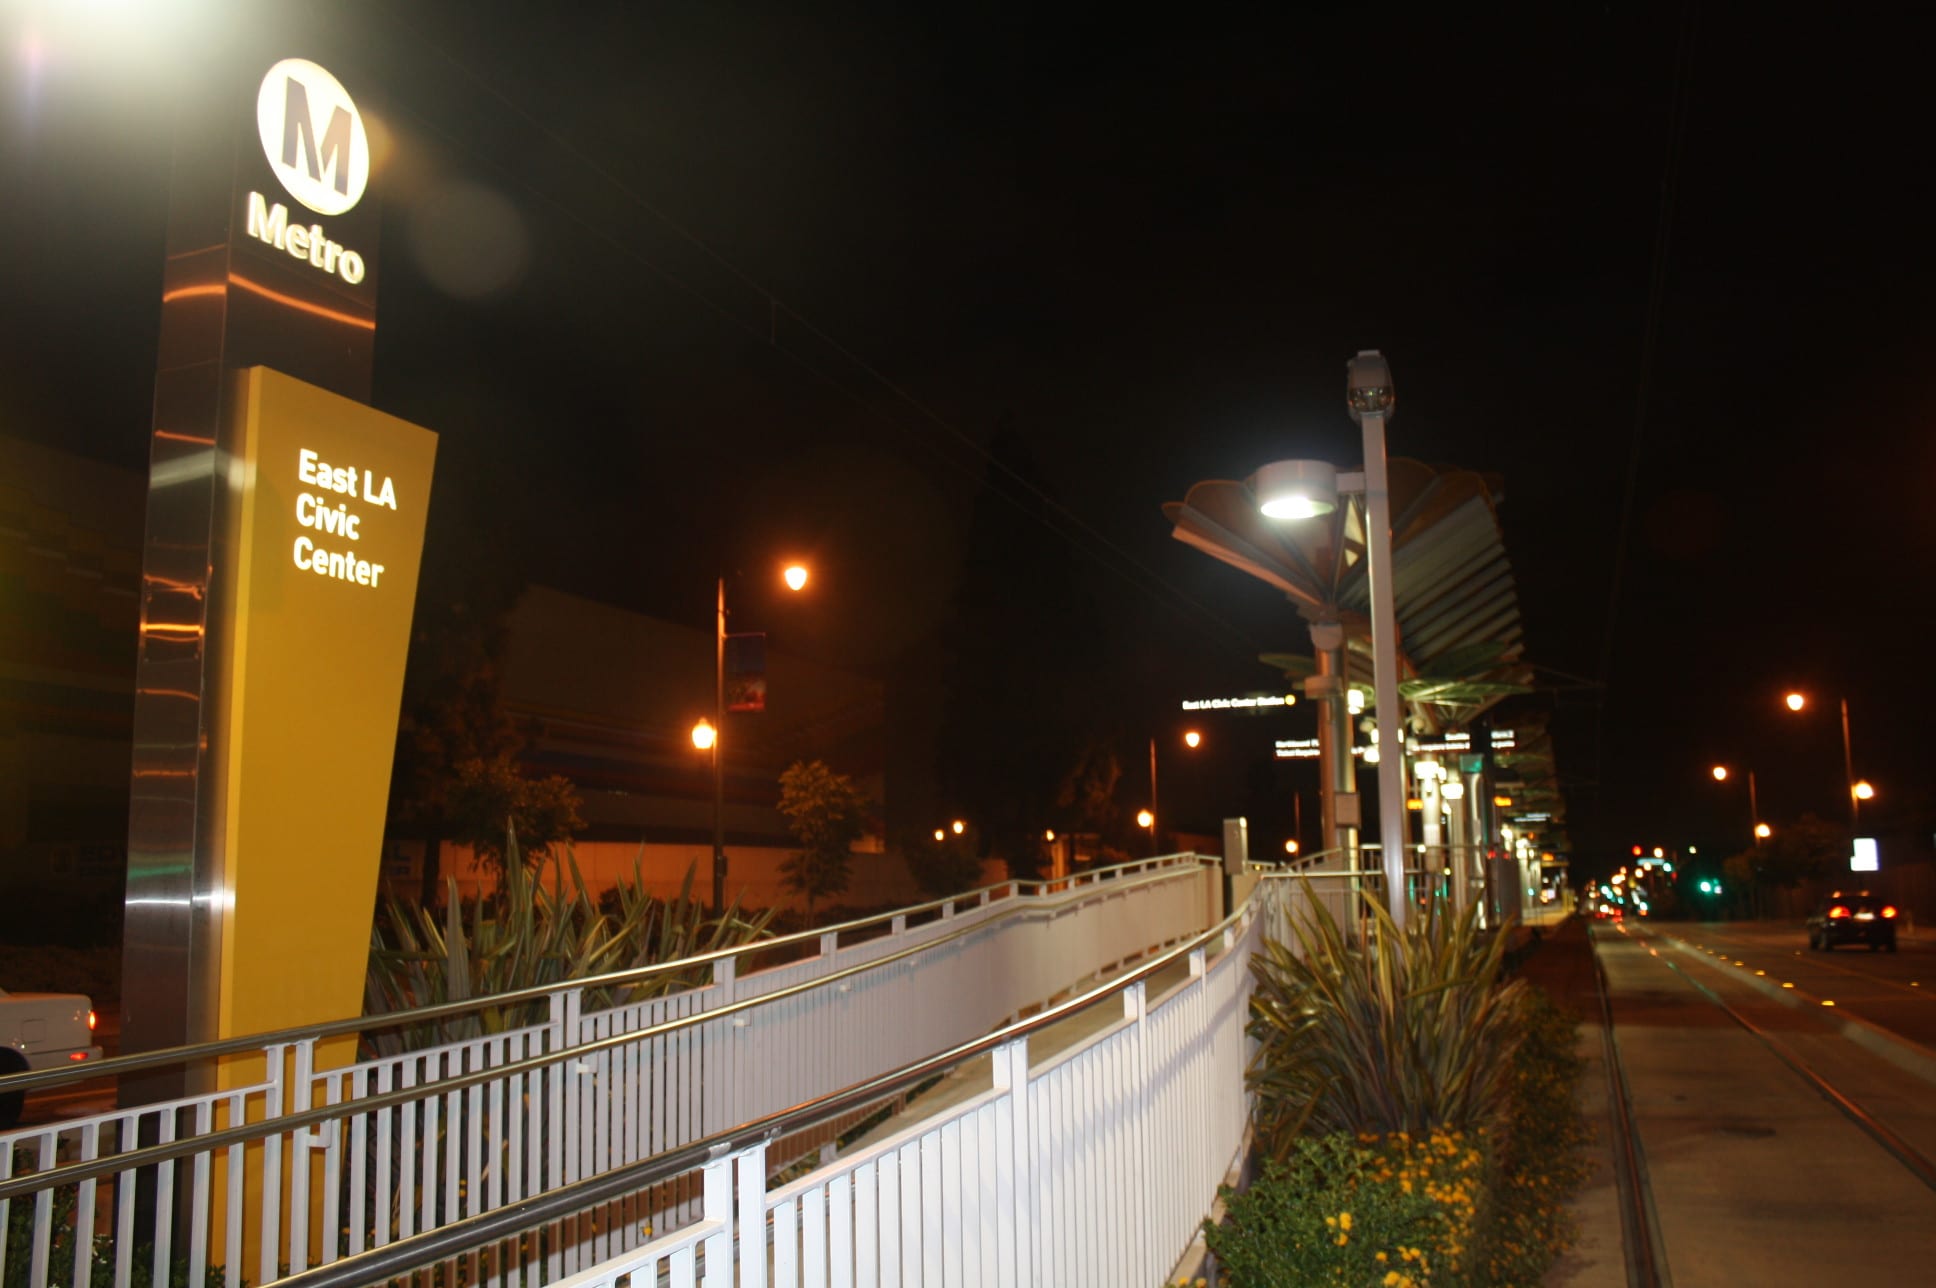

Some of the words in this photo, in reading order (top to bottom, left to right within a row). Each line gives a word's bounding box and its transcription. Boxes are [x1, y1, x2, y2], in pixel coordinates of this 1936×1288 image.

[281, 75, 352, 197] M
[247, 190, 366, 284] Metro
[299, 448, 358, 498] East
[363, 469, 398, 511] LA
[296, 492, 361, 541] Civic
[293, 536, 385, 588] Center
